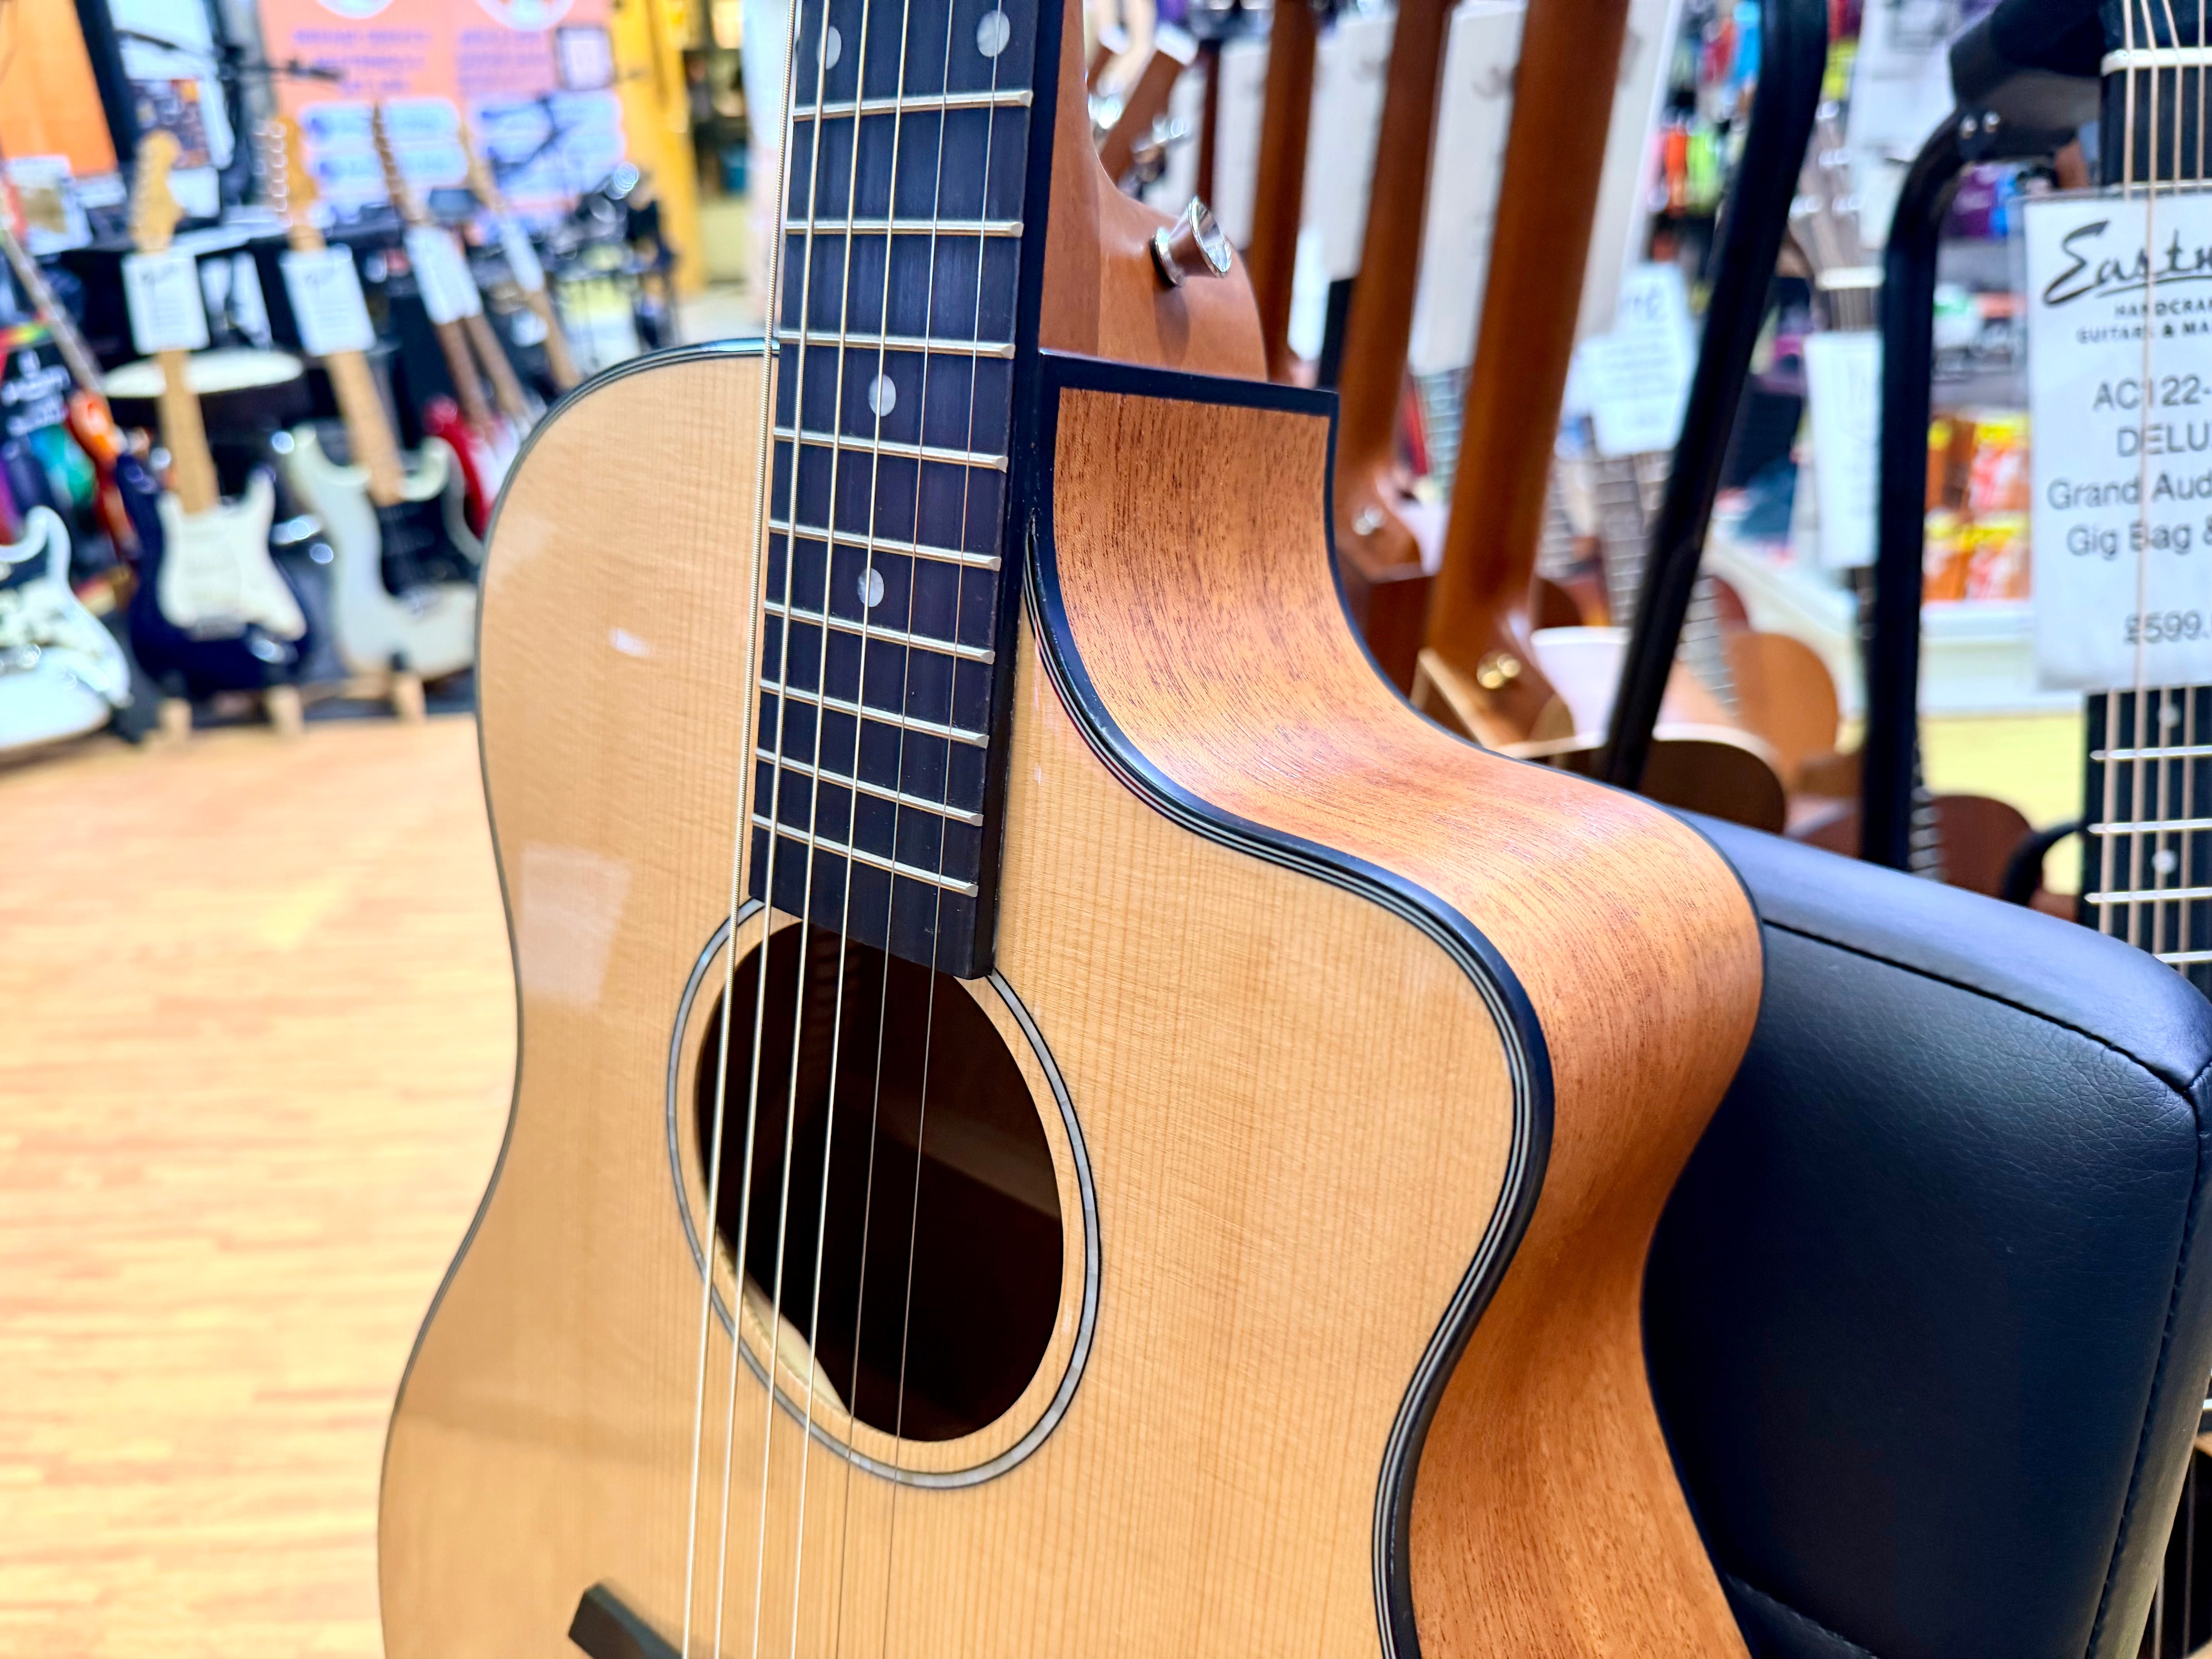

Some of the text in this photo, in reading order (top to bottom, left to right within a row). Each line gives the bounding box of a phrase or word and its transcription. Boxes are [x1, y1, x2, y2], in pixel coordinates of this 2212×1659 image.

[2118, 419, 2212, 457] DELU
[2047, 477, 2142, 510] Grand
[2067, 523, 2118, 561] Gig
